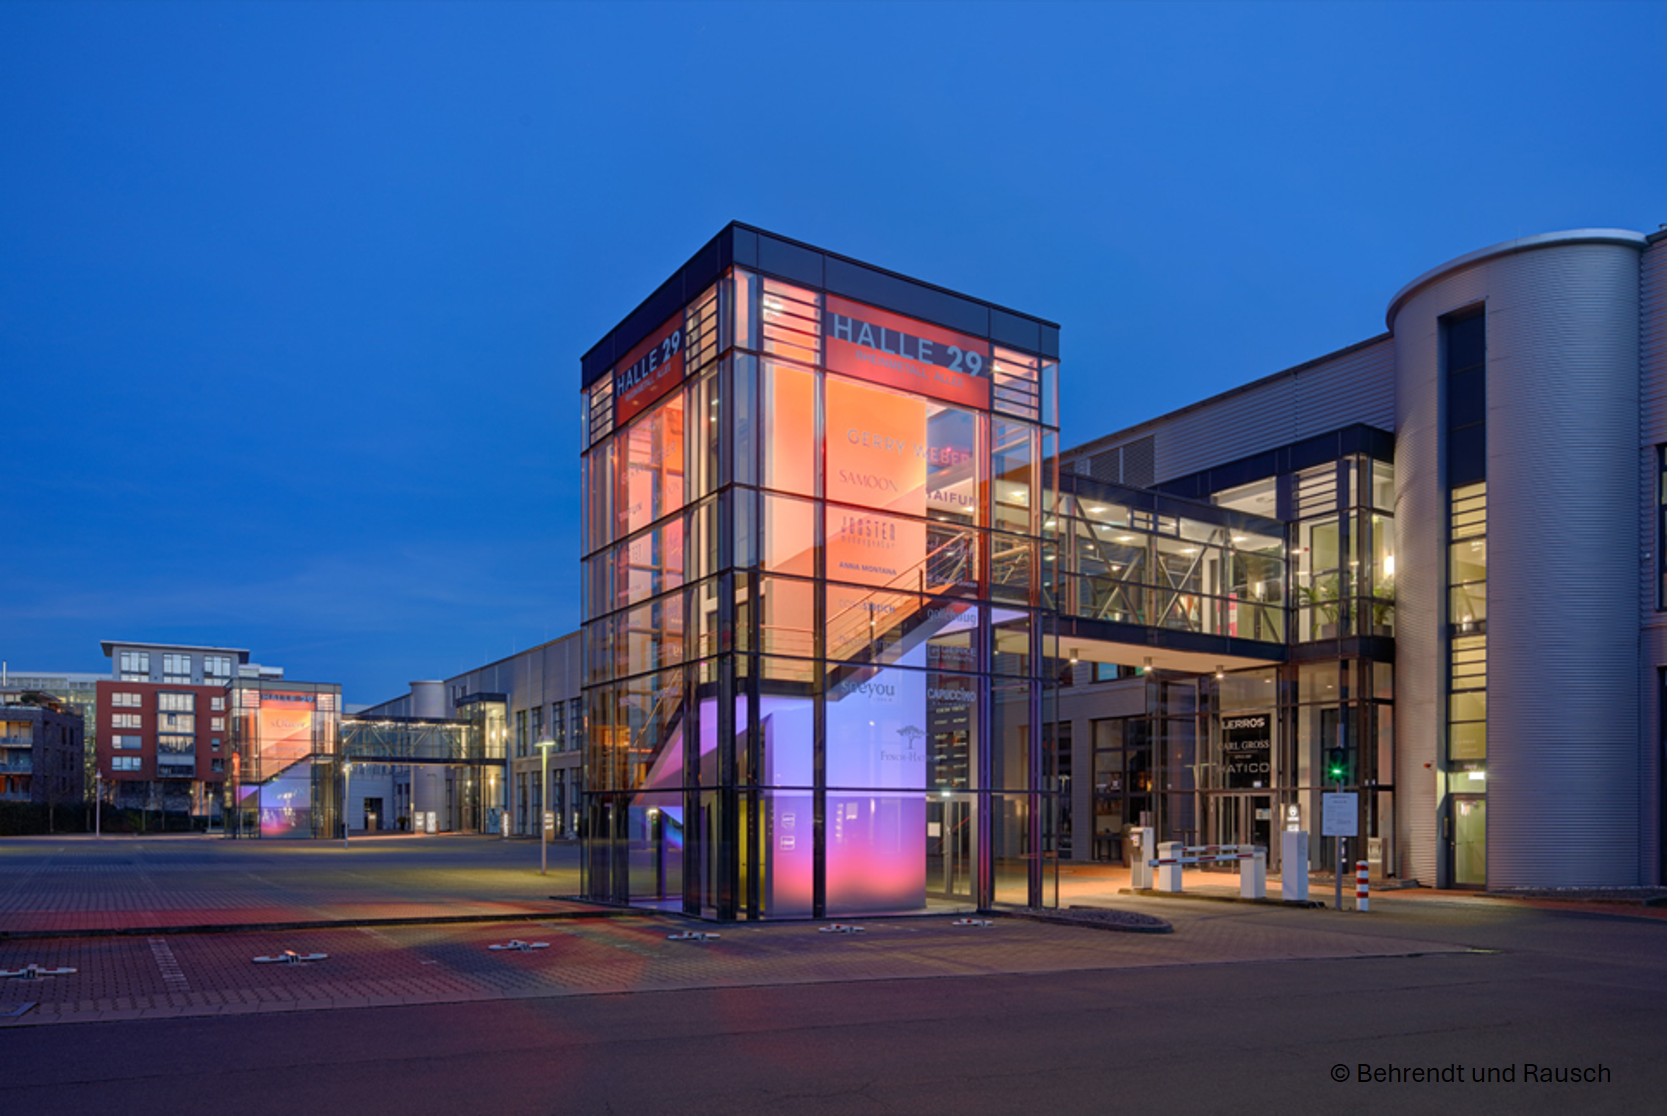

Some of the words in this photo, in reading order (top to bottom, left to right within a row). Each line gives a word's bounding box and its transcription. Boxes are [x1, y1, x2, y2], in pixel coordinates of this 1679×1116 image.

[833, 313, 935, 365] HALLE
[946, 345, 983, 377] 29
[616, 348, 658, 398] HALLE
[662, 330, 681, 363] 29
[847, 428, 906, 455] GERRY
[913, 443, 970, 466] WEBER
[838, 468, 898, 492] SAMOON
[262, 694, 295, 702] HALLE
[300, 695, 314, 703] 29
[1221, 717, 1266, 730] LERROS
[1241, 739, 1270, 750] GROSS
